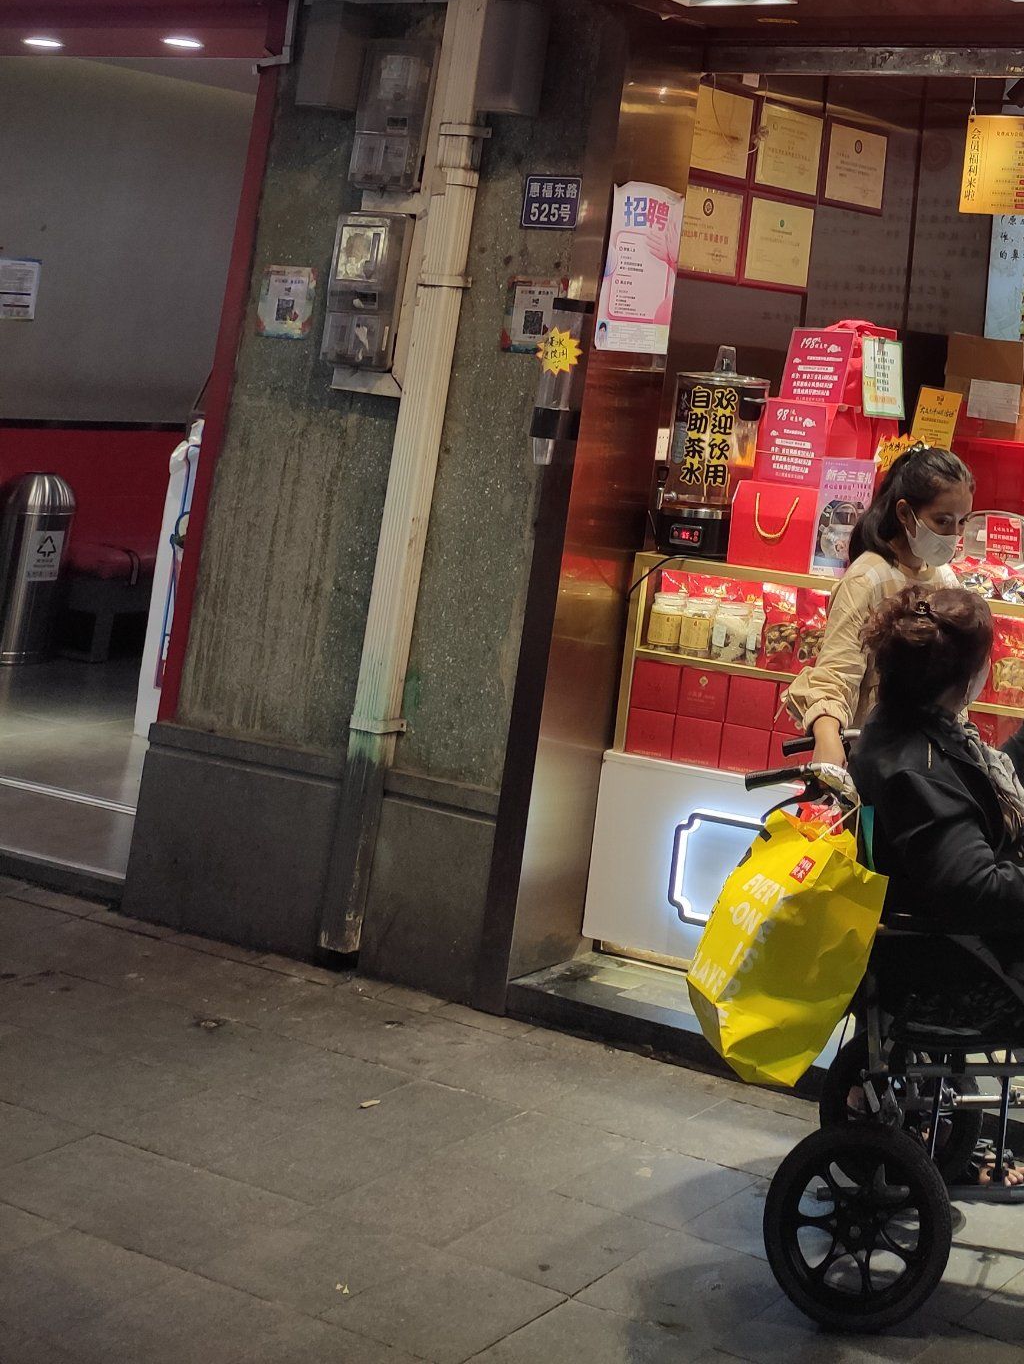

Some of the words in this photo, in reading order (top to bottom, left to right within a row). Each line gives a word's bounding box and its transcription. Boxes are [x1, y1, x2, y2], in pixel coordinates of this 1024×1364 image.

[528, 182, 578, 199] 惠福东路
[963, 127, 983, 203] 会员福利来啦
[529, 202, 572, 223] 525号
[624, 195, 670, 232] 招聘
[680, 386, 712, 485] 自助茶水
[704, 388, 738, 486] 欢迎饮用
